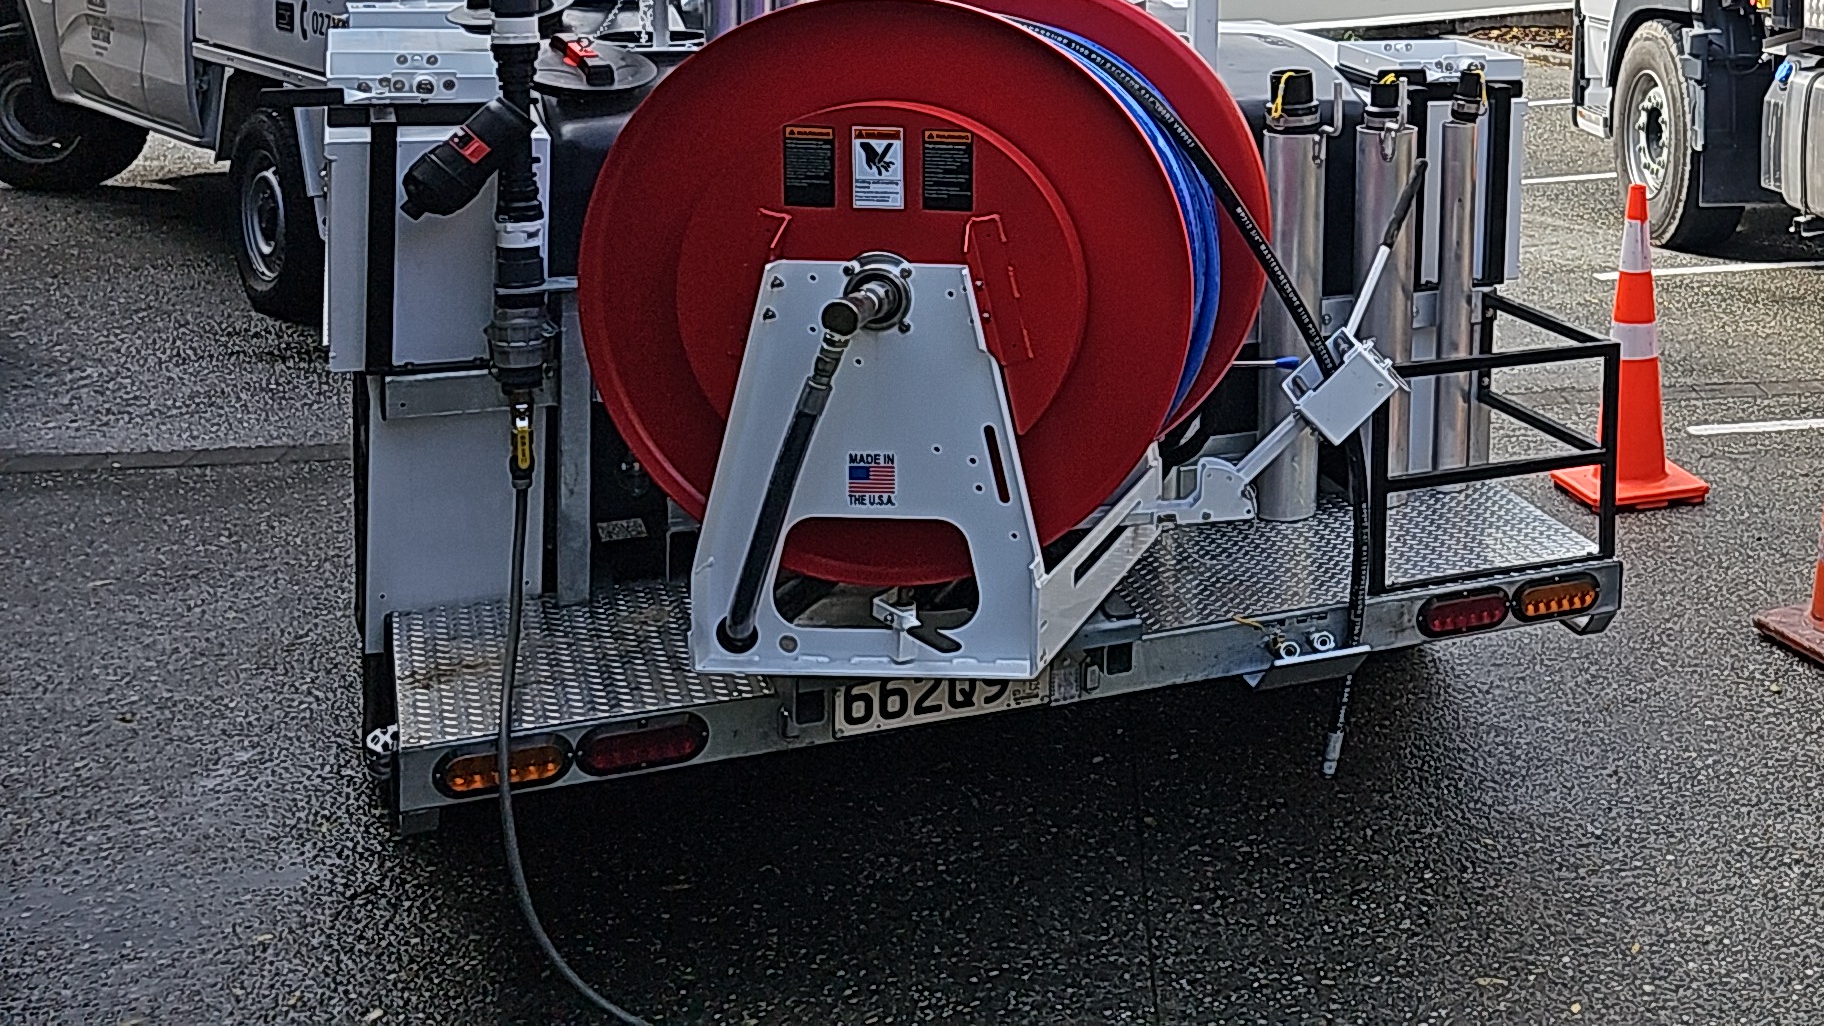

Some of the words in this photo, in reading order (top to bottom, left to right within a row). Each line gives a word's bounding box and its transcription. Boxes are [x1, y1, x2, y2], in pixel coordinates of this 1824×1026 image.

[849, 453, 881, 465] MADE
[883, 454, 894, 465] IN
[848, 494, 867, 506] THE
